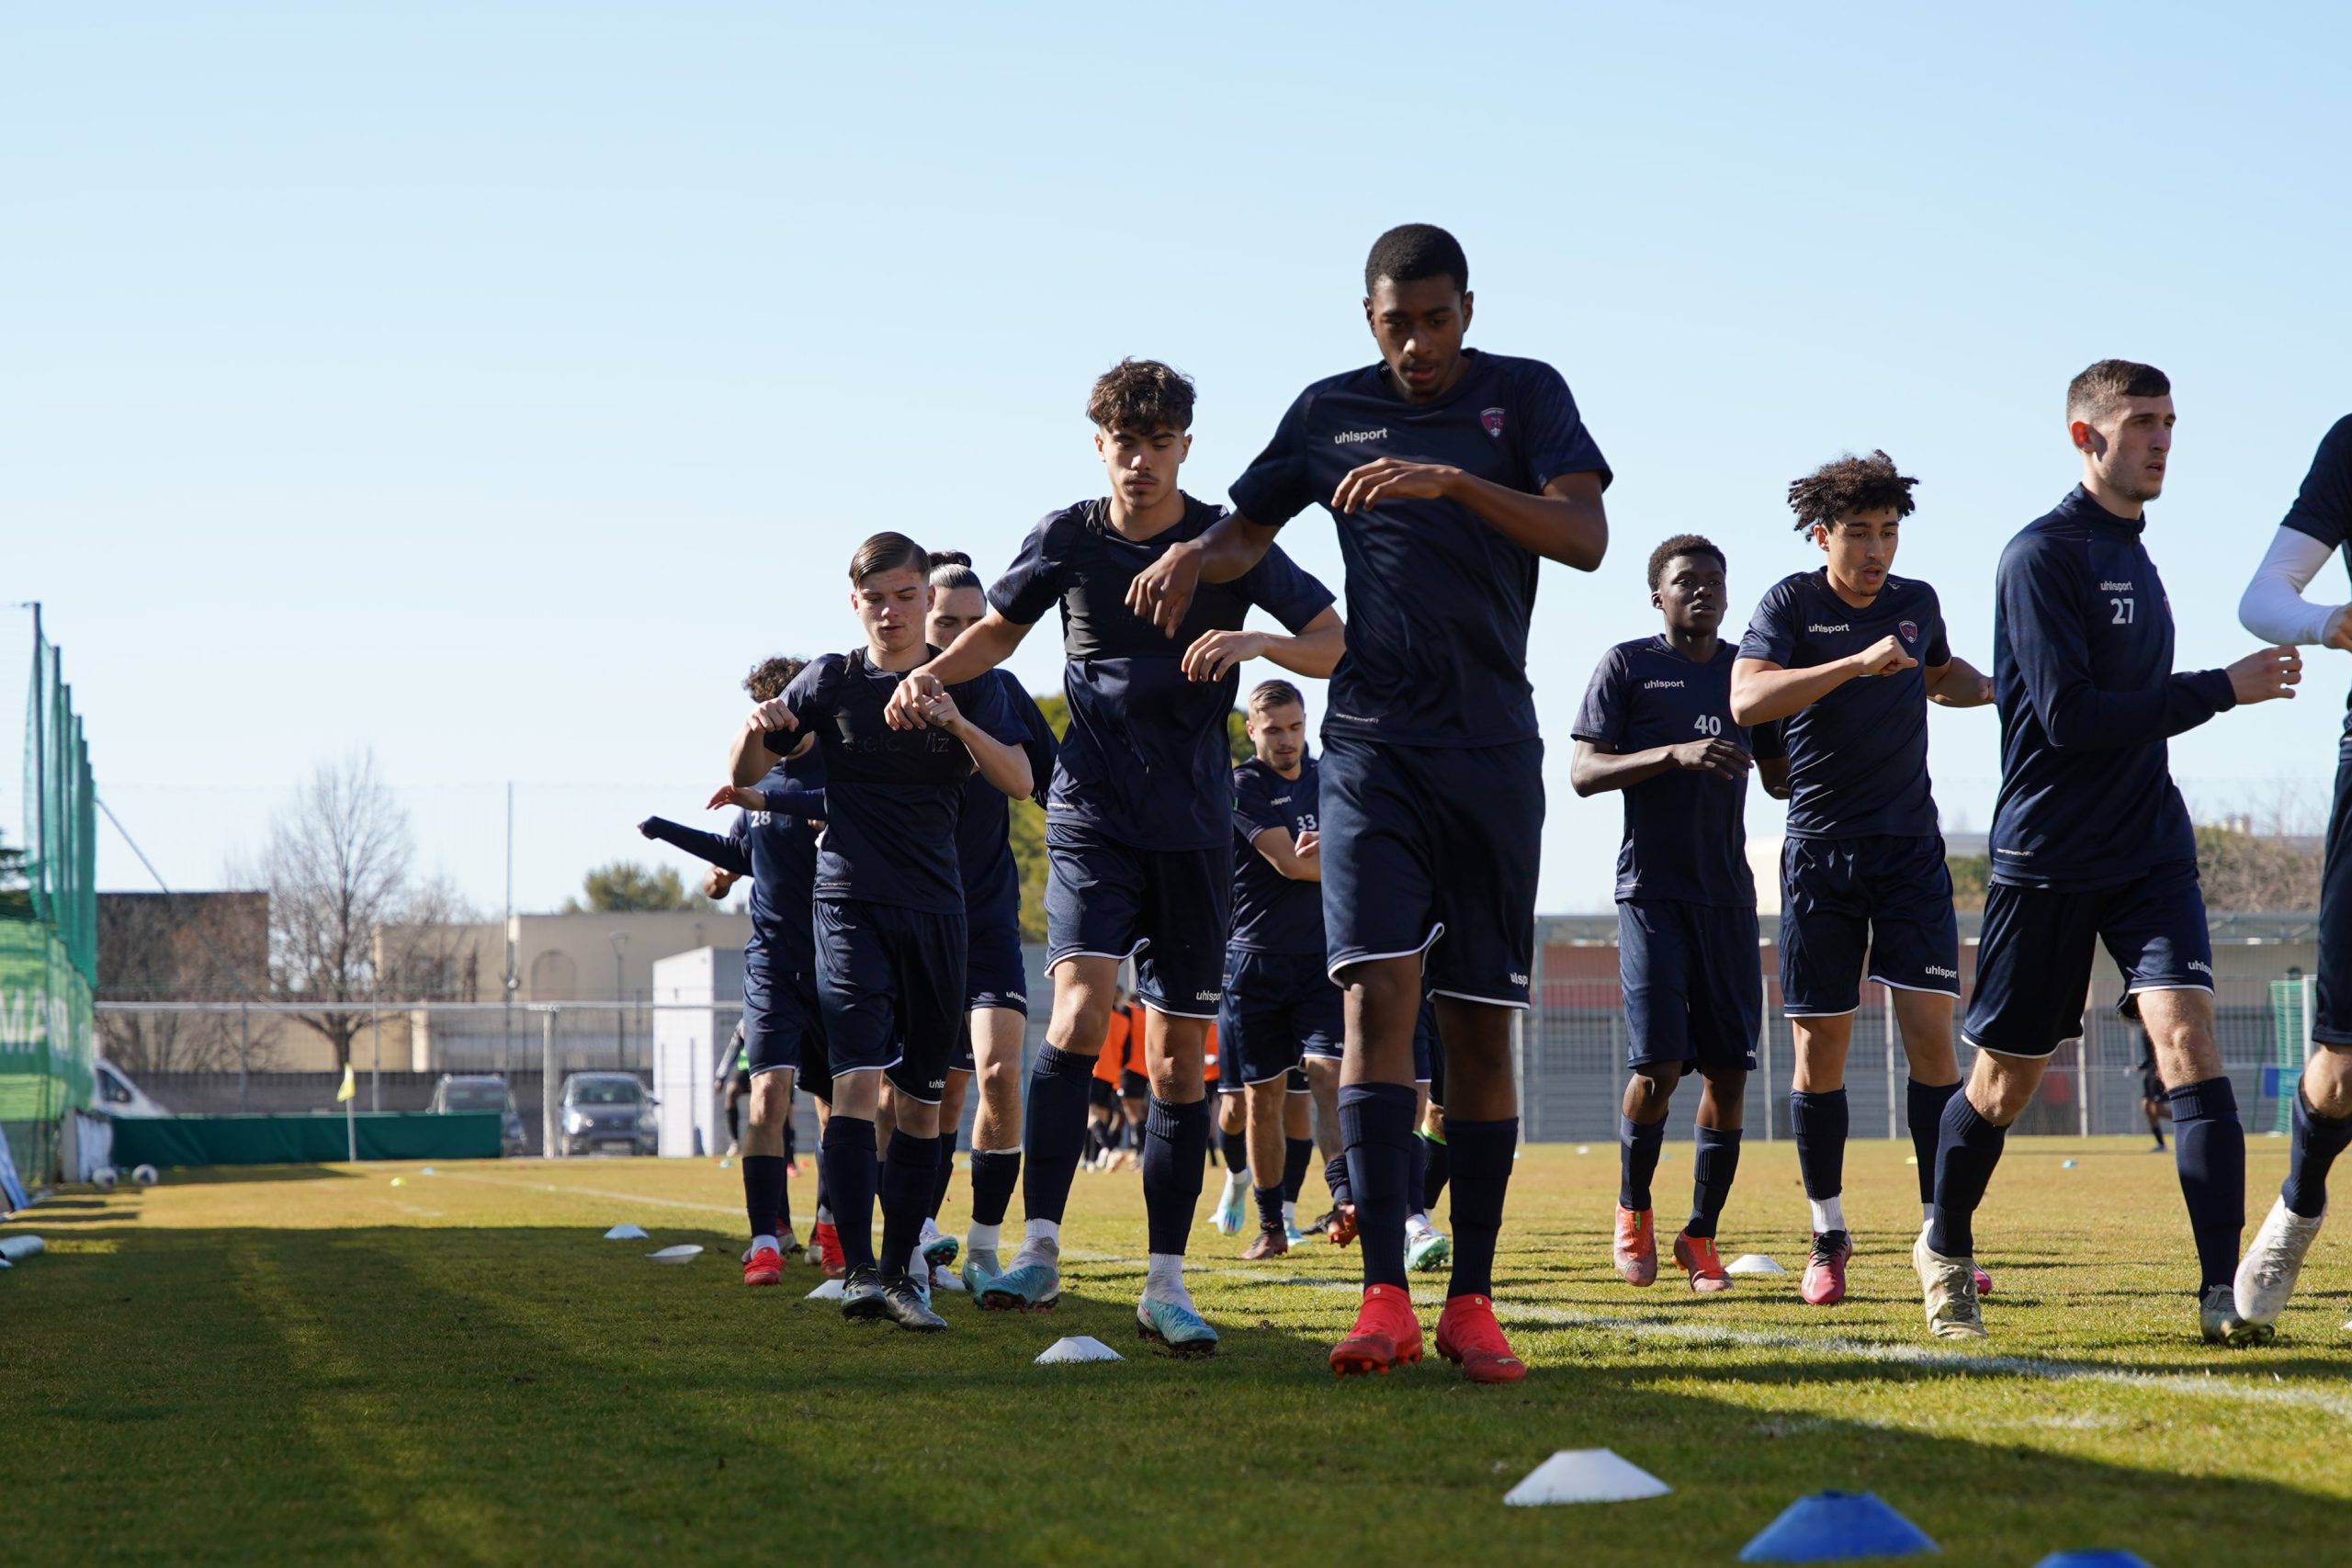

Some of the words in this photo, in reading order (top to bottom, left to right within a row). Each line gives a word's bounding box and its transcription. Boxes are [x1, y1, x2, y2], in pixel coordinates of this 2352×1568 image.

[1334, 427, 1388, 445] uhlsport
[2100, 581, 2134, 593] uhlsport
[2110, 597, 2134, 625] 27
[1807, 623, 1849, 634] uhlsport
[1644, 678, 1686, 691] uhlsport
[1693, 714, 1723, 737] 40
[750, 810, 772, 829] 28
[1296, 813, 1318, 832] 33
